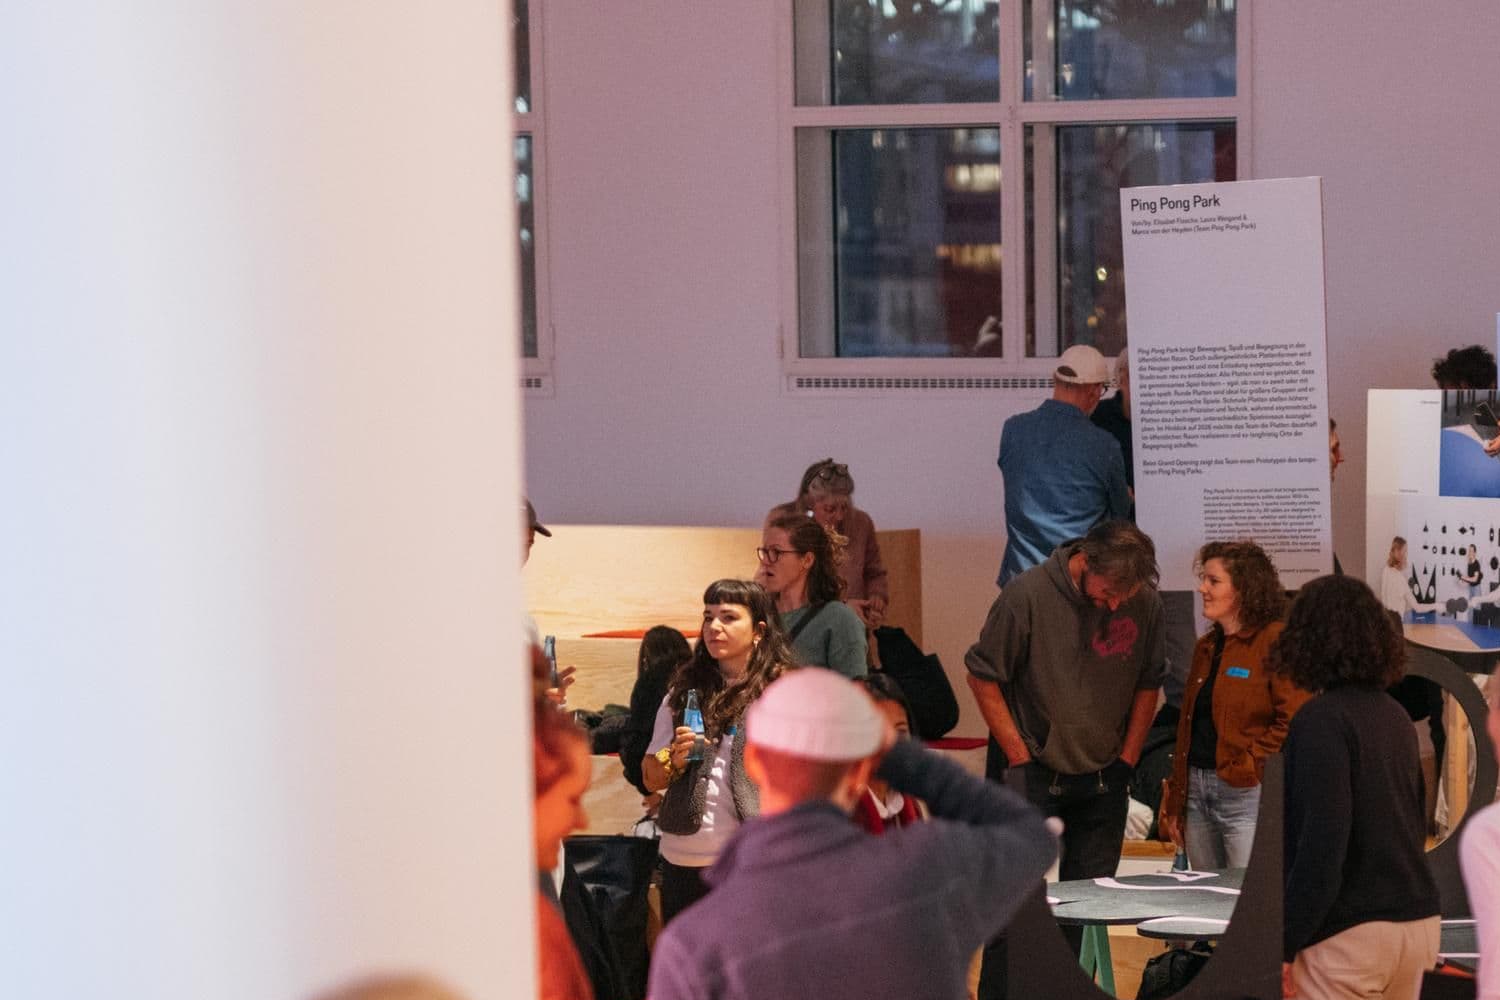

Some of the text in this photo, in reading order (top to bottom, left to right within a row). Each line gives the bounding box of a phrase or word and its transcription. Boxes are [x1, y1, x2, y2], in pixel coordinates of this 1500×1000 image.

[1131, 194, 1221, 213] Ping Pong Park
